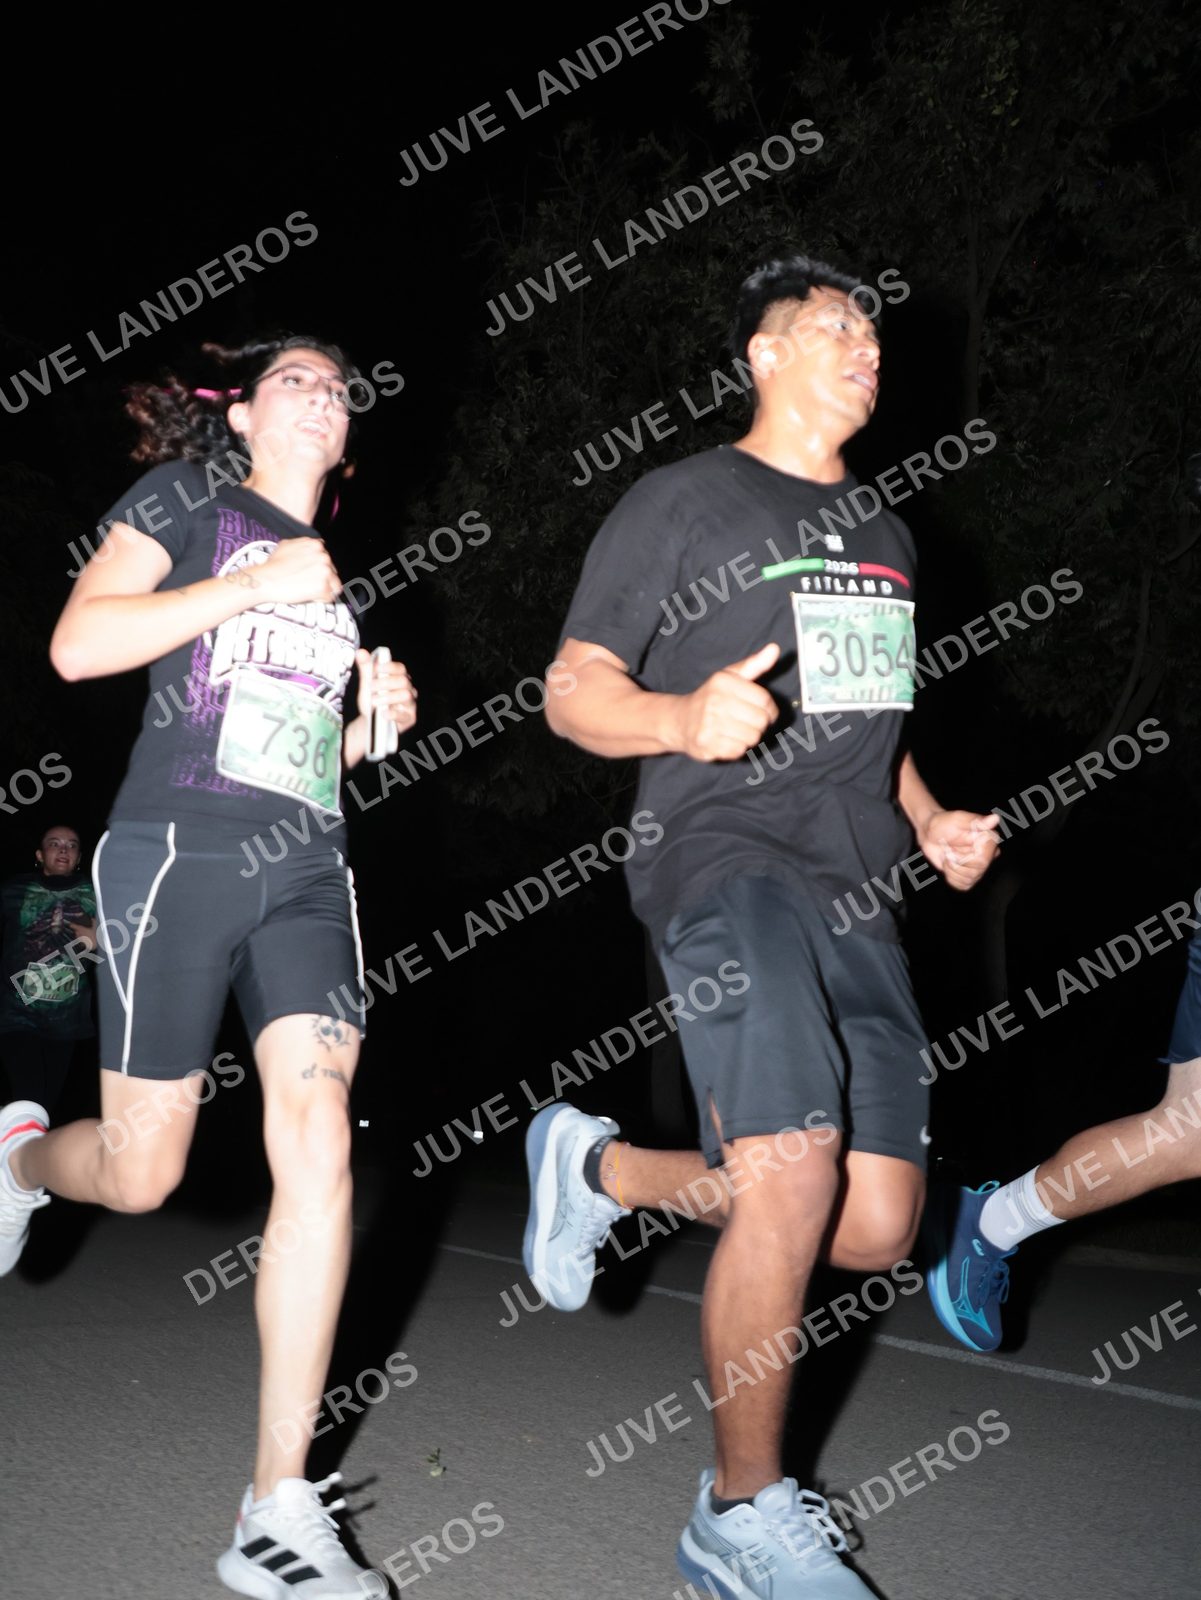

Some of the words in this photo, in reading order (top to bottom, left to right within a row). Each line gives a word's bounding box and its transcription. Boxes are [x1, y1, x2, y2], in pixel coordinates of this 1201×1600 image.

[824, 559, 859, 575] 2026
[801, 576, 893, 595] FITLAND
[817, 631, 914, 677] 3054
